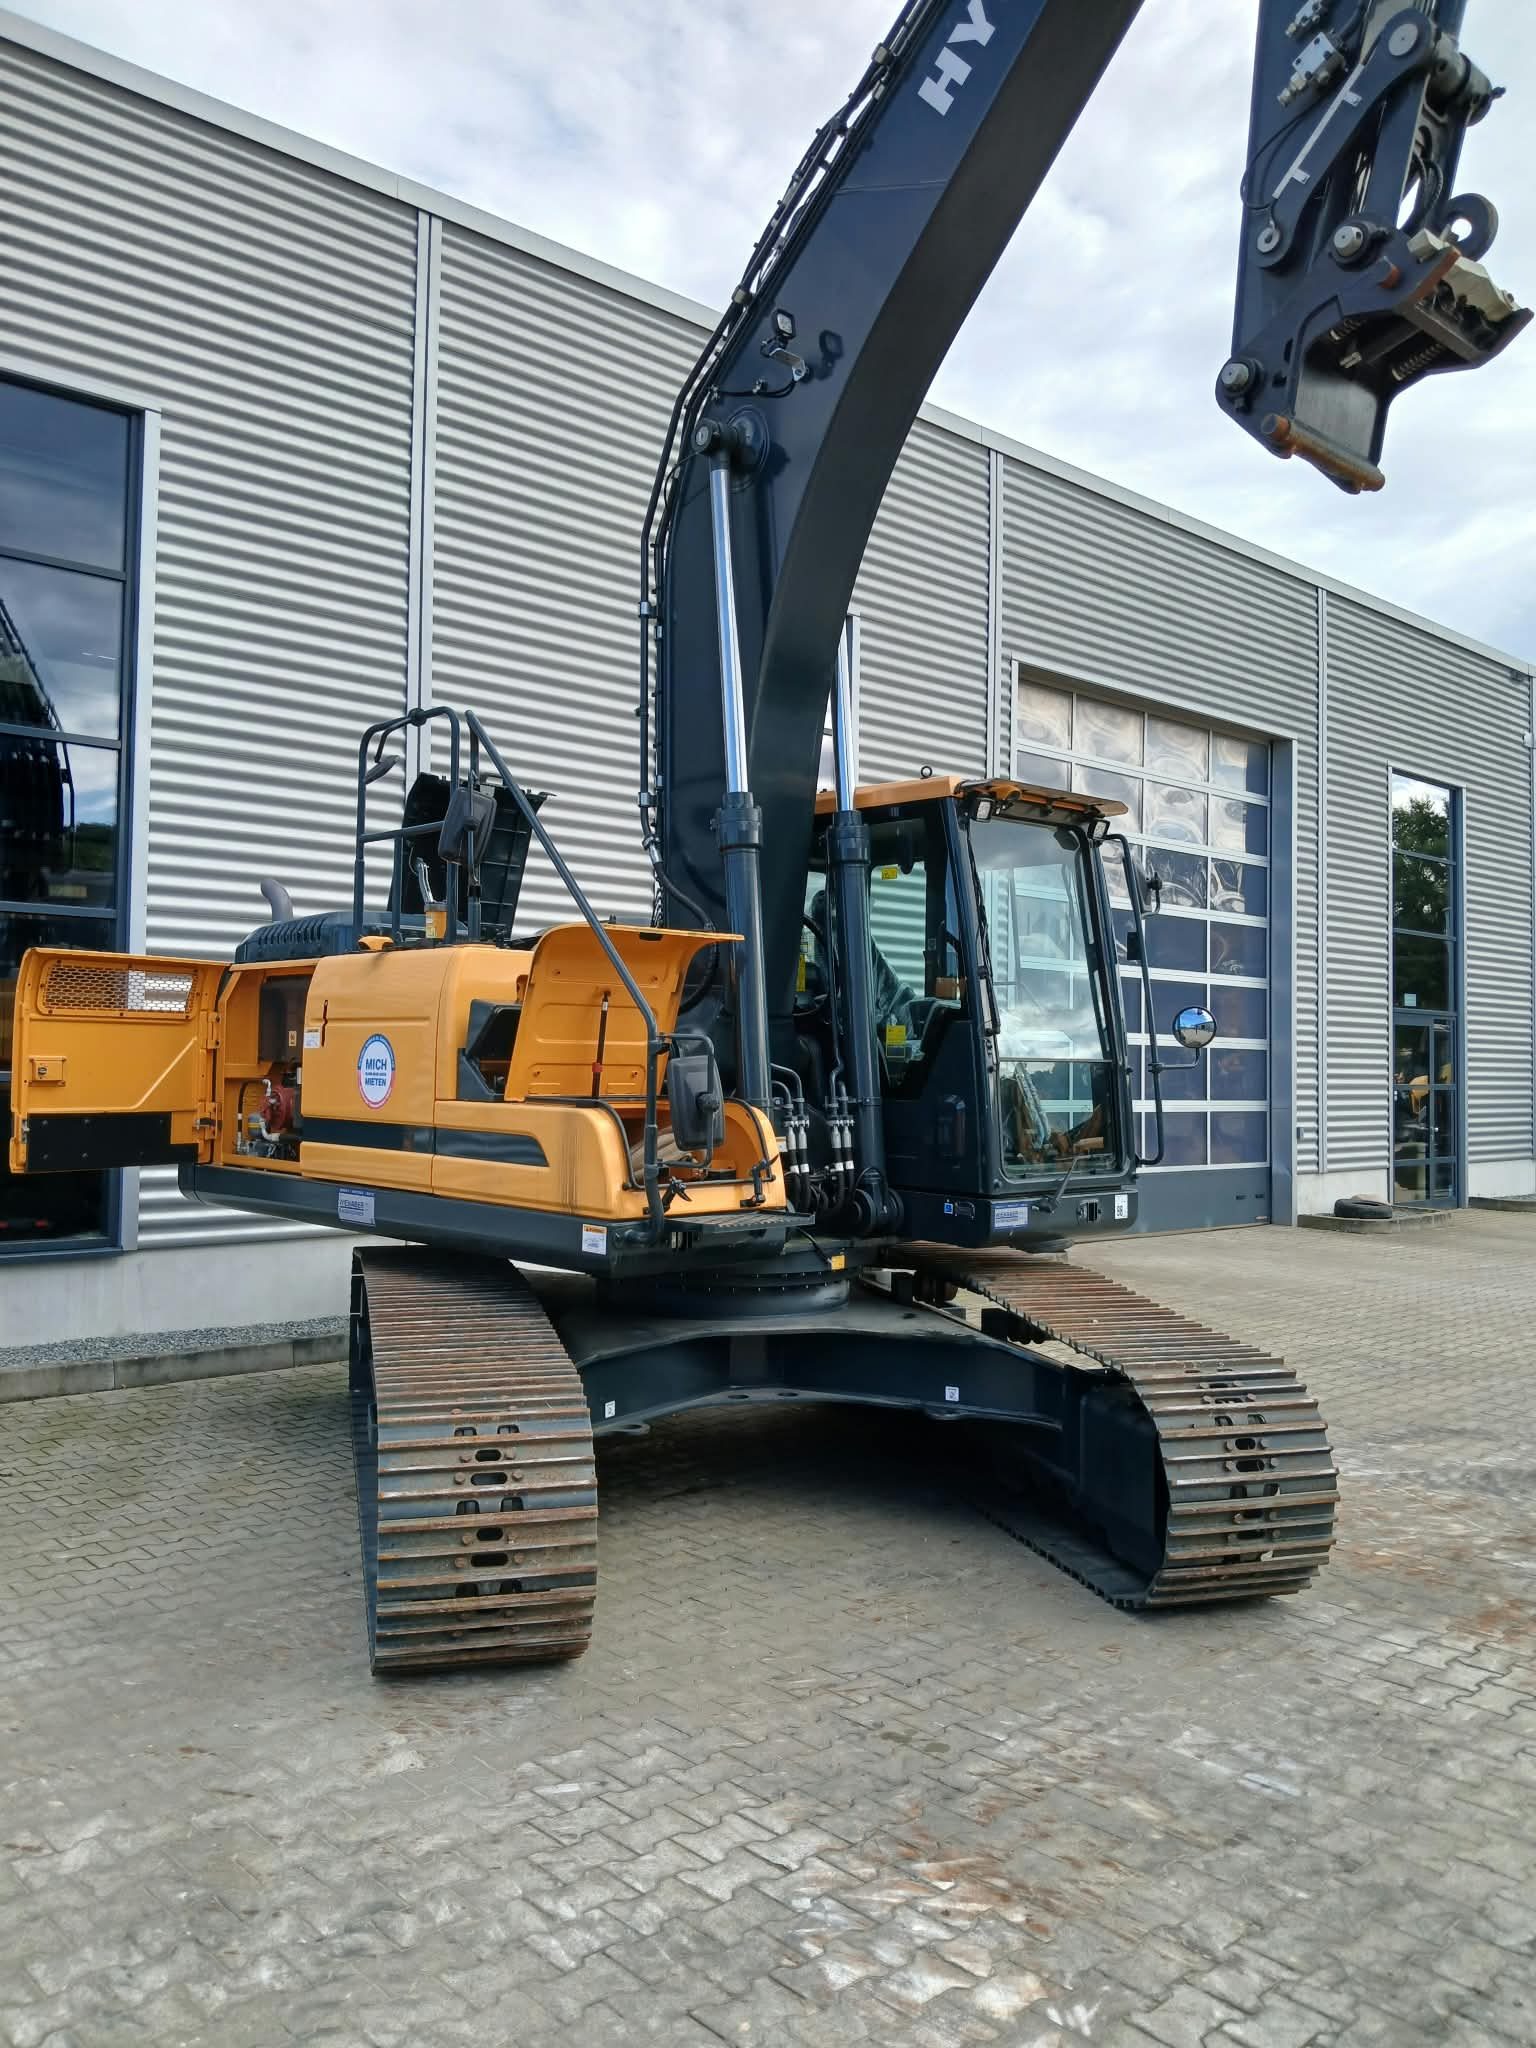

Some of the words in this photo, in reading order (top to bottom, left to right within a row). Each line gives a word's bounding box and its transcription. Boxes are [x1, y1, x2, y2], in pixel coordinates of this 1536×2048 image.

[917, 0, 996, 117] HY
[365, 1058, 388, 1071] MICH
[364, 1077, 387, 1087] MIETEN
